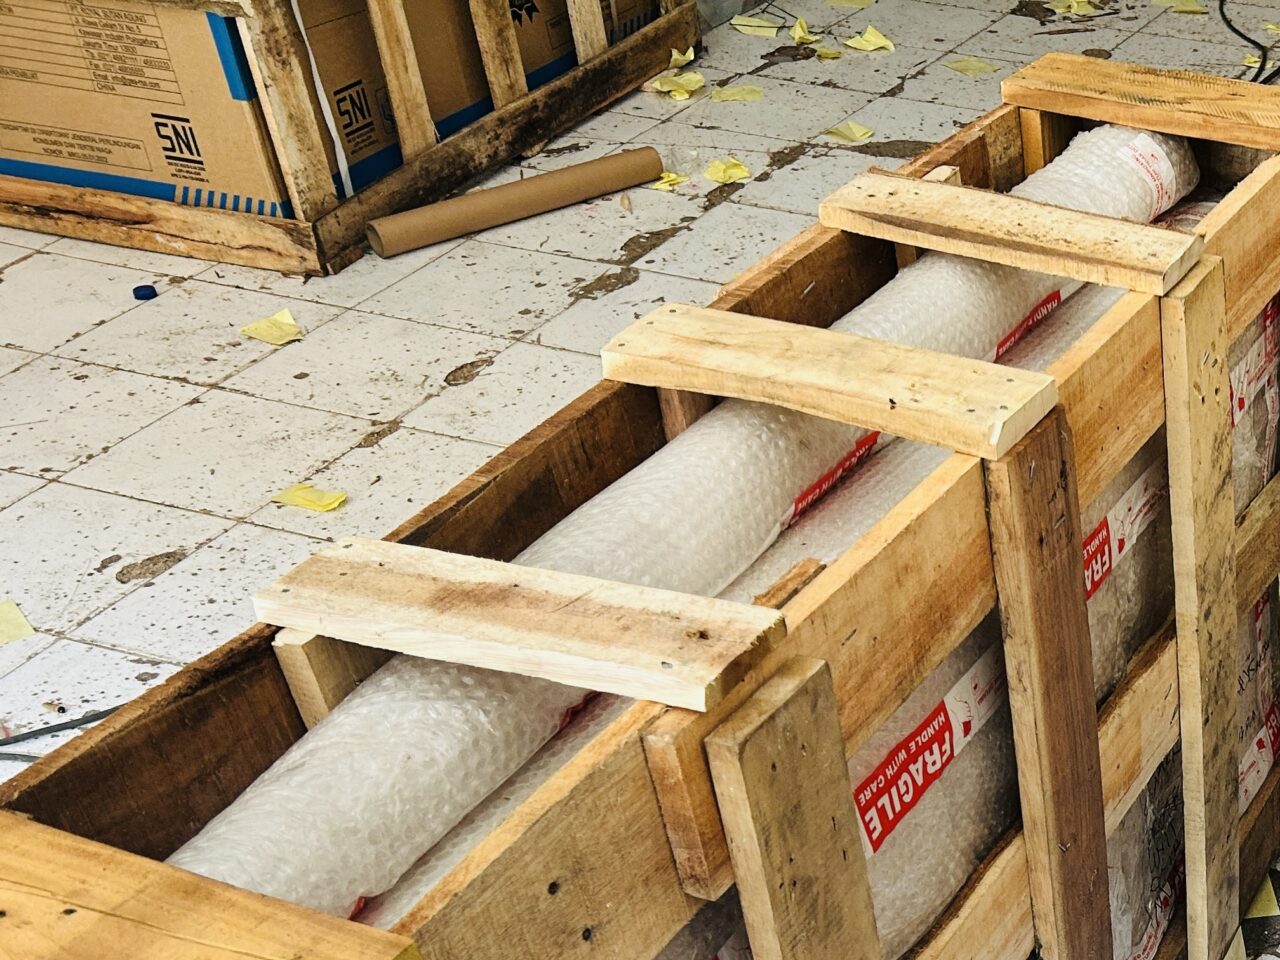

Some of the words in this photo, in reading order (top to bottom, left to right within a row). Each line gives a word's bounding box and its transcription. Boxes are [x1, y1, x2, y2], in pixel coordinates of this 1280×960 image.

[336, 87, 372, 131] SNI
[154, 121, 202, 158] SNI
[1082, 526, 1108, 561] HANDLE
[1084, 543, 1110, 592] FRA
[908, 711, 946, 754] HANDLE
[885, 750, 908, 779] WITH
[857, 774, 885, 807] CARE
[864, 729, 952, 842] FRAGILE
